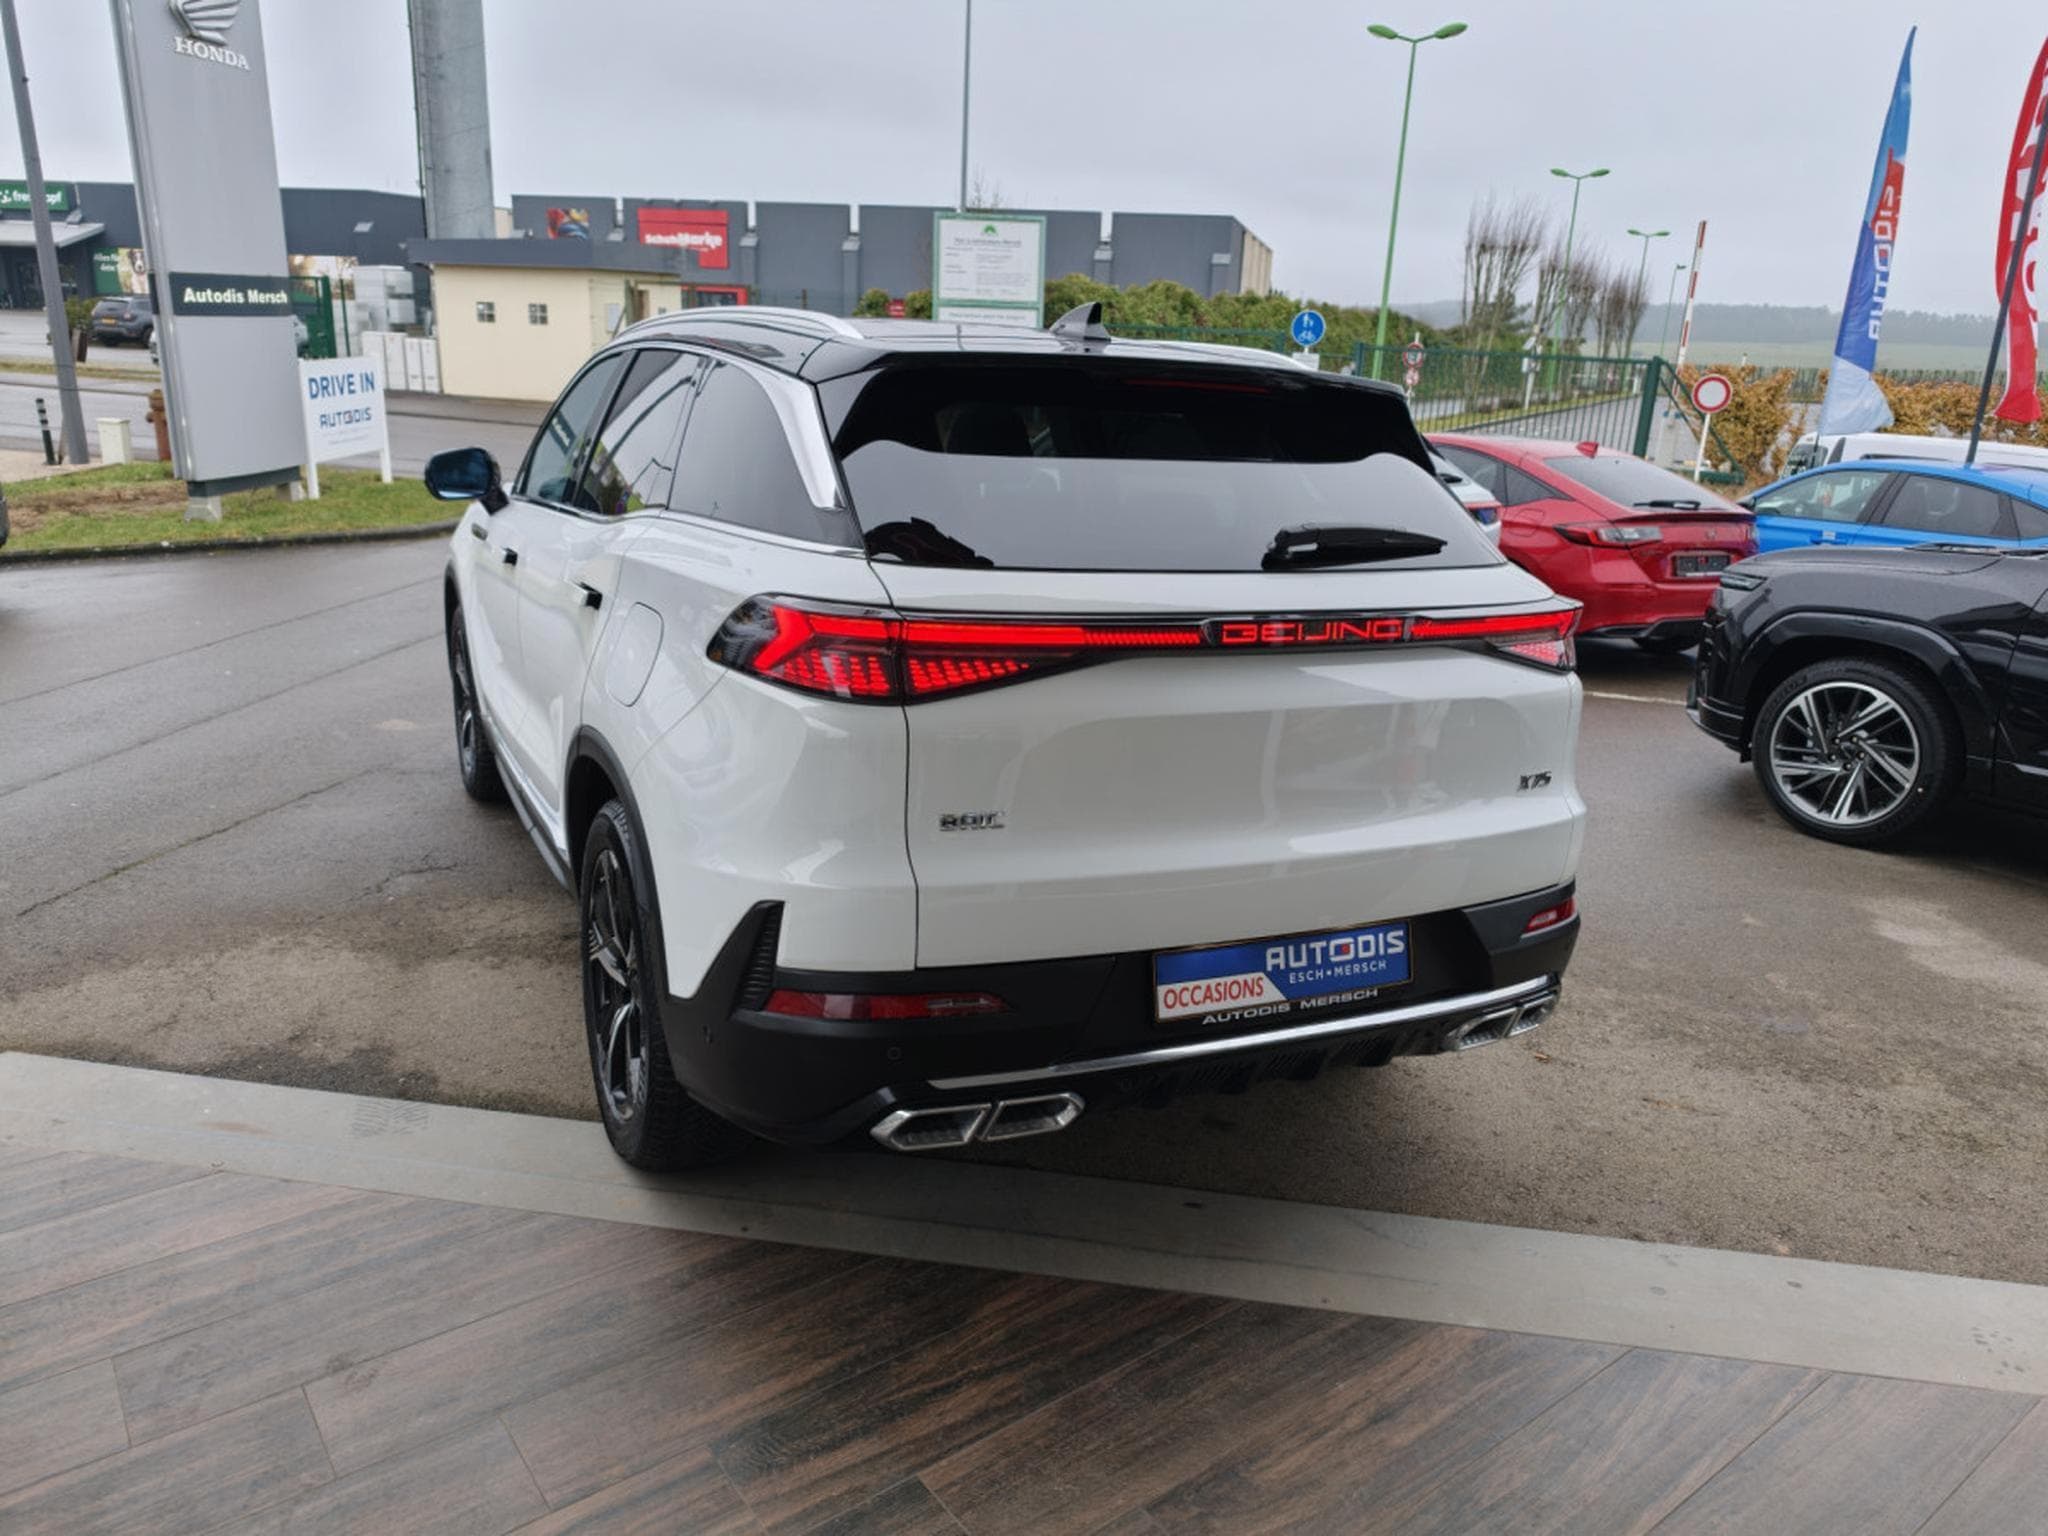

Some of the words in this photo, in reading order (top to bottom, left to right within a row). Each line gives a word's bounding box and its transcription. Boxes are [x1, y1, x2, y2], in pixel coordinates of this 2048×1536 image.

[174, 36, 251, 71] HONDA
[183, 286, 245, 303] Autodis
[247, 288, 288, 304] Mersch
[308, 373, 356, 400] DRIVE
[360, 371, 375, 393] IN
[320, 406, 372, 429] AUTODIS
[1265, 930, 1405, 971] AUTODIS
[1163, 976, 1264, 1010] OCCASIONS
[1202, 1002, 1291, 1025] AUTODIS
[1300, 988, 1379, 1010] MERSCH
